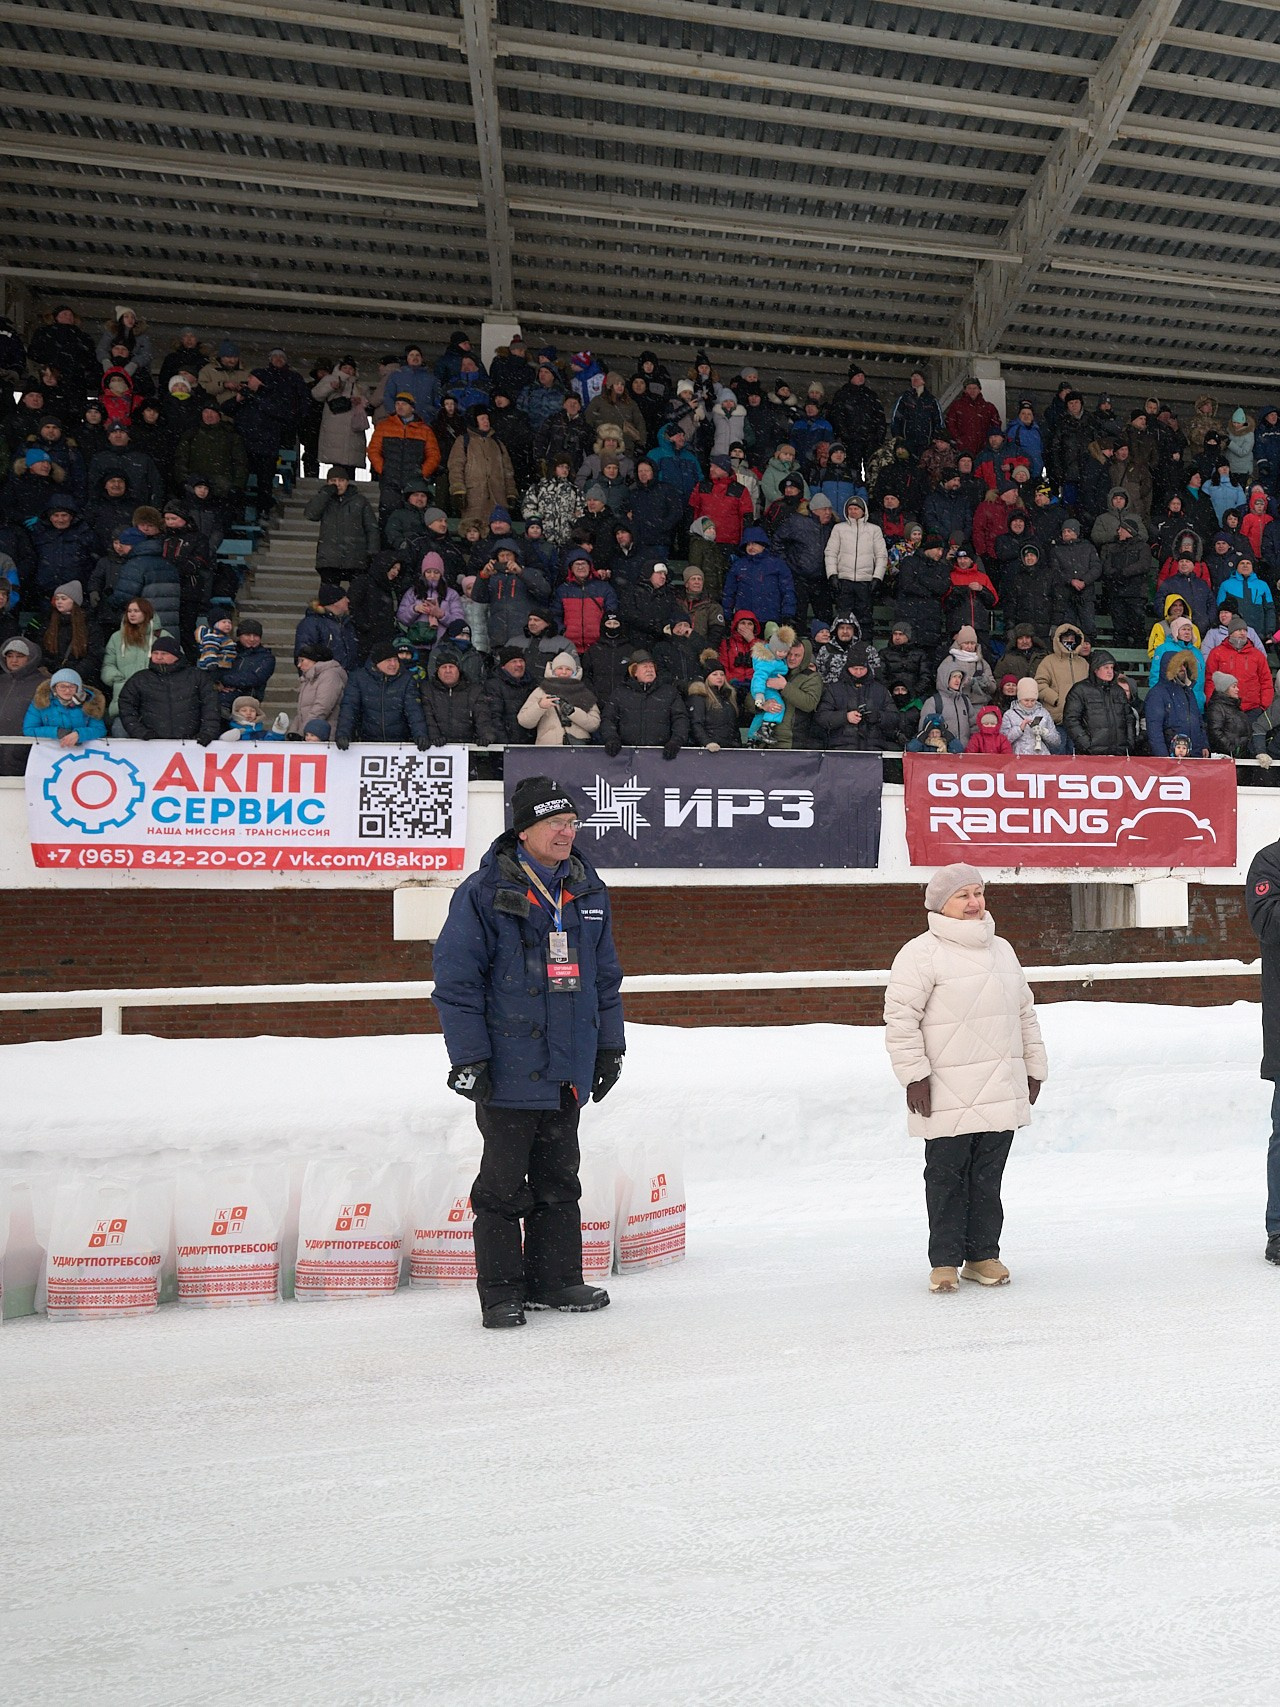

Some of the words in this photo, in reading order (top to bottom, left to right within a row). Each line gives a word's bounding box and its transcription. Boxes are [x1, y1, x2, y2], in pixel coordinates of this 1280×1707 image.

[152, 751, 328, 794] АКПП
[151, 796, 326, 826] СЕРВИС
[664, 787, 815, 828] ИРЗ
[147, 826, 182, 836] НАША
[185, 828, 236, 836] МИССИЯ
[245, 828, 331, 837] ТРАНСМИССИЯ
[47, 848, 72, 864] +7
[78, 848, 134, 867] (965)
[141, 850, 266, 866] 842-20-02
[289, 850, 448, 869] vk.com/18akpp
[52, 1255, 161, 1268] УДМУРТПОТРЕБСОЮЗ
